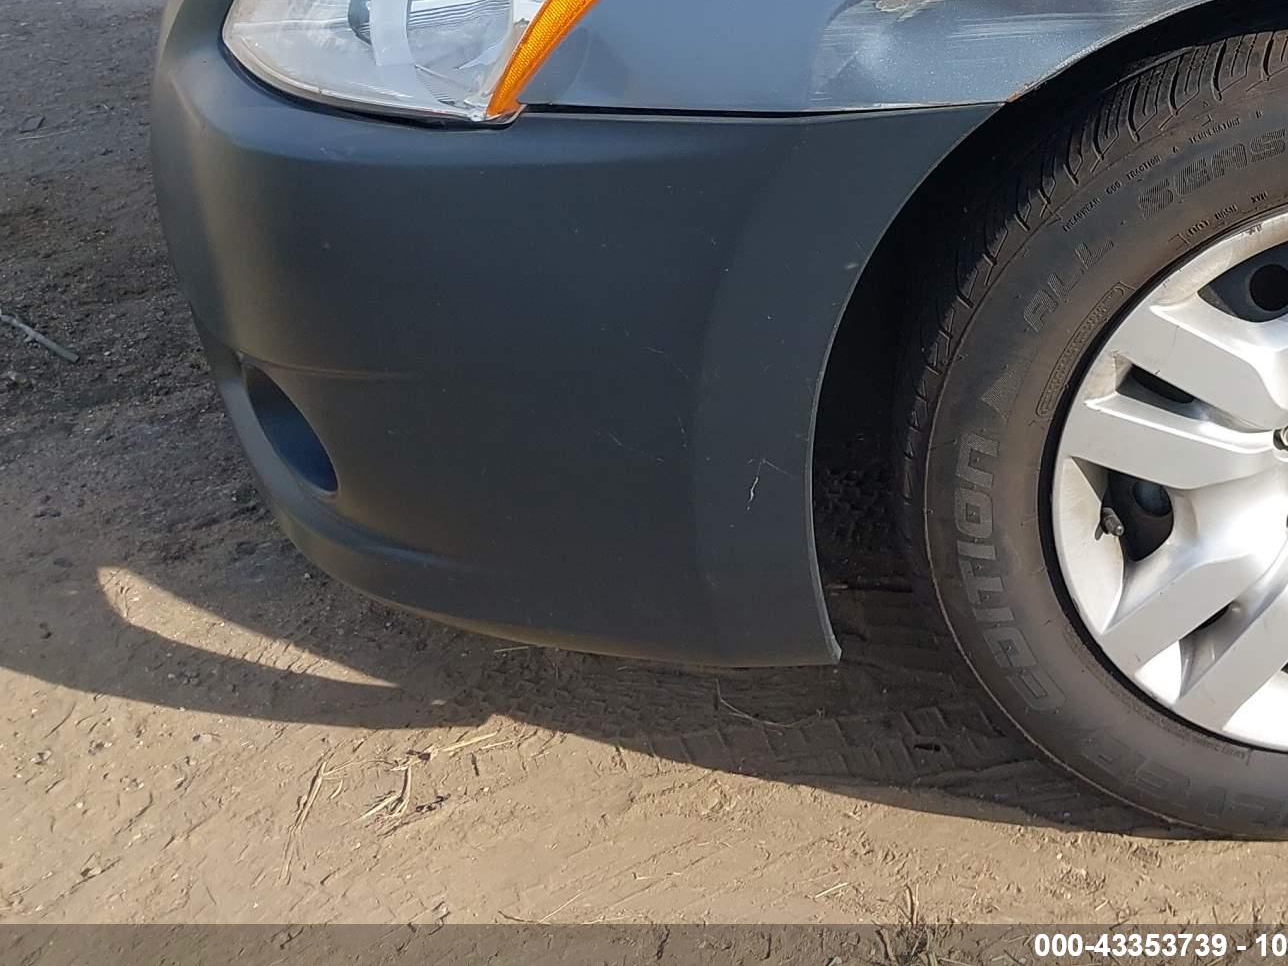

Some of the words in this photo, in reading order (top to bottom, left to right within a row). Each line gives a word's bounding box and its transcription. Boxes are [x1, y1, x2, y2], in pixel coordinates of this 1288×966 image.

[1062, 197, 1101, 233] TREADWEAR
[1125, 153, 1162, 181] TRACTION
[1188, 117, 1241, 145] TEMPERATURE
[1023, 240, 1115, 332] ALL
[954, 433, 1067, 712] EDITION
